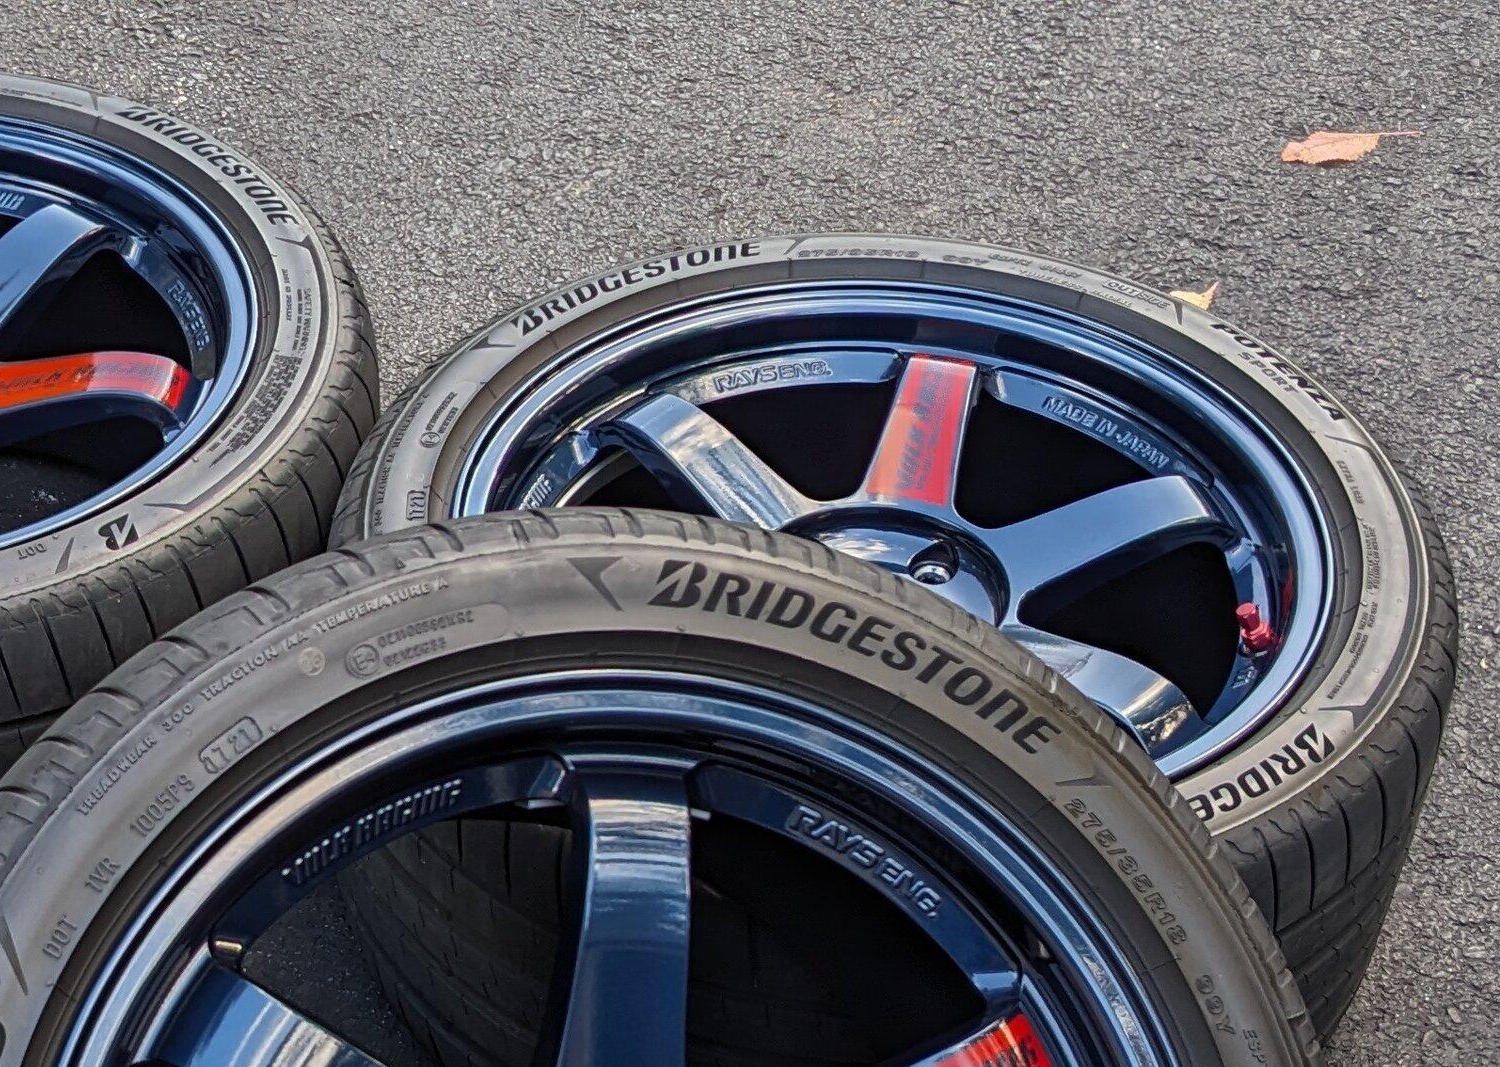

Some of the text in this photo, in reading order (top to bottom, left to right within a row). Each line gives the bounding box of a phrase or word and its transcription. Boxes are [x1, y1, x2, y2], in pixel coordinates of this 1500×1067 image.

[117, 105, 300, 227] BRIDGESTONE
[511, 243, 760, 335] BRIDGESTONE
[713, 364, 776, 393] RAYS
[1042, 396, 1169, 467] MADE IN JAPAN
[18, 543, 47, 560] DOT
[77, 735, 157, 817] TREADWEAR
[162, 701, 194, 731] 300
[201, 648, 278, 701] TRACTION
[314, 580, 431, 633] TEMPERATURE
[647, 560, 1060, 753] BRIDGESTONE
[1064, 799, 1187, 945] 275/35R18
[788, 806, 883, 870] RAYS
[42, 913, 78, 960] DOT
